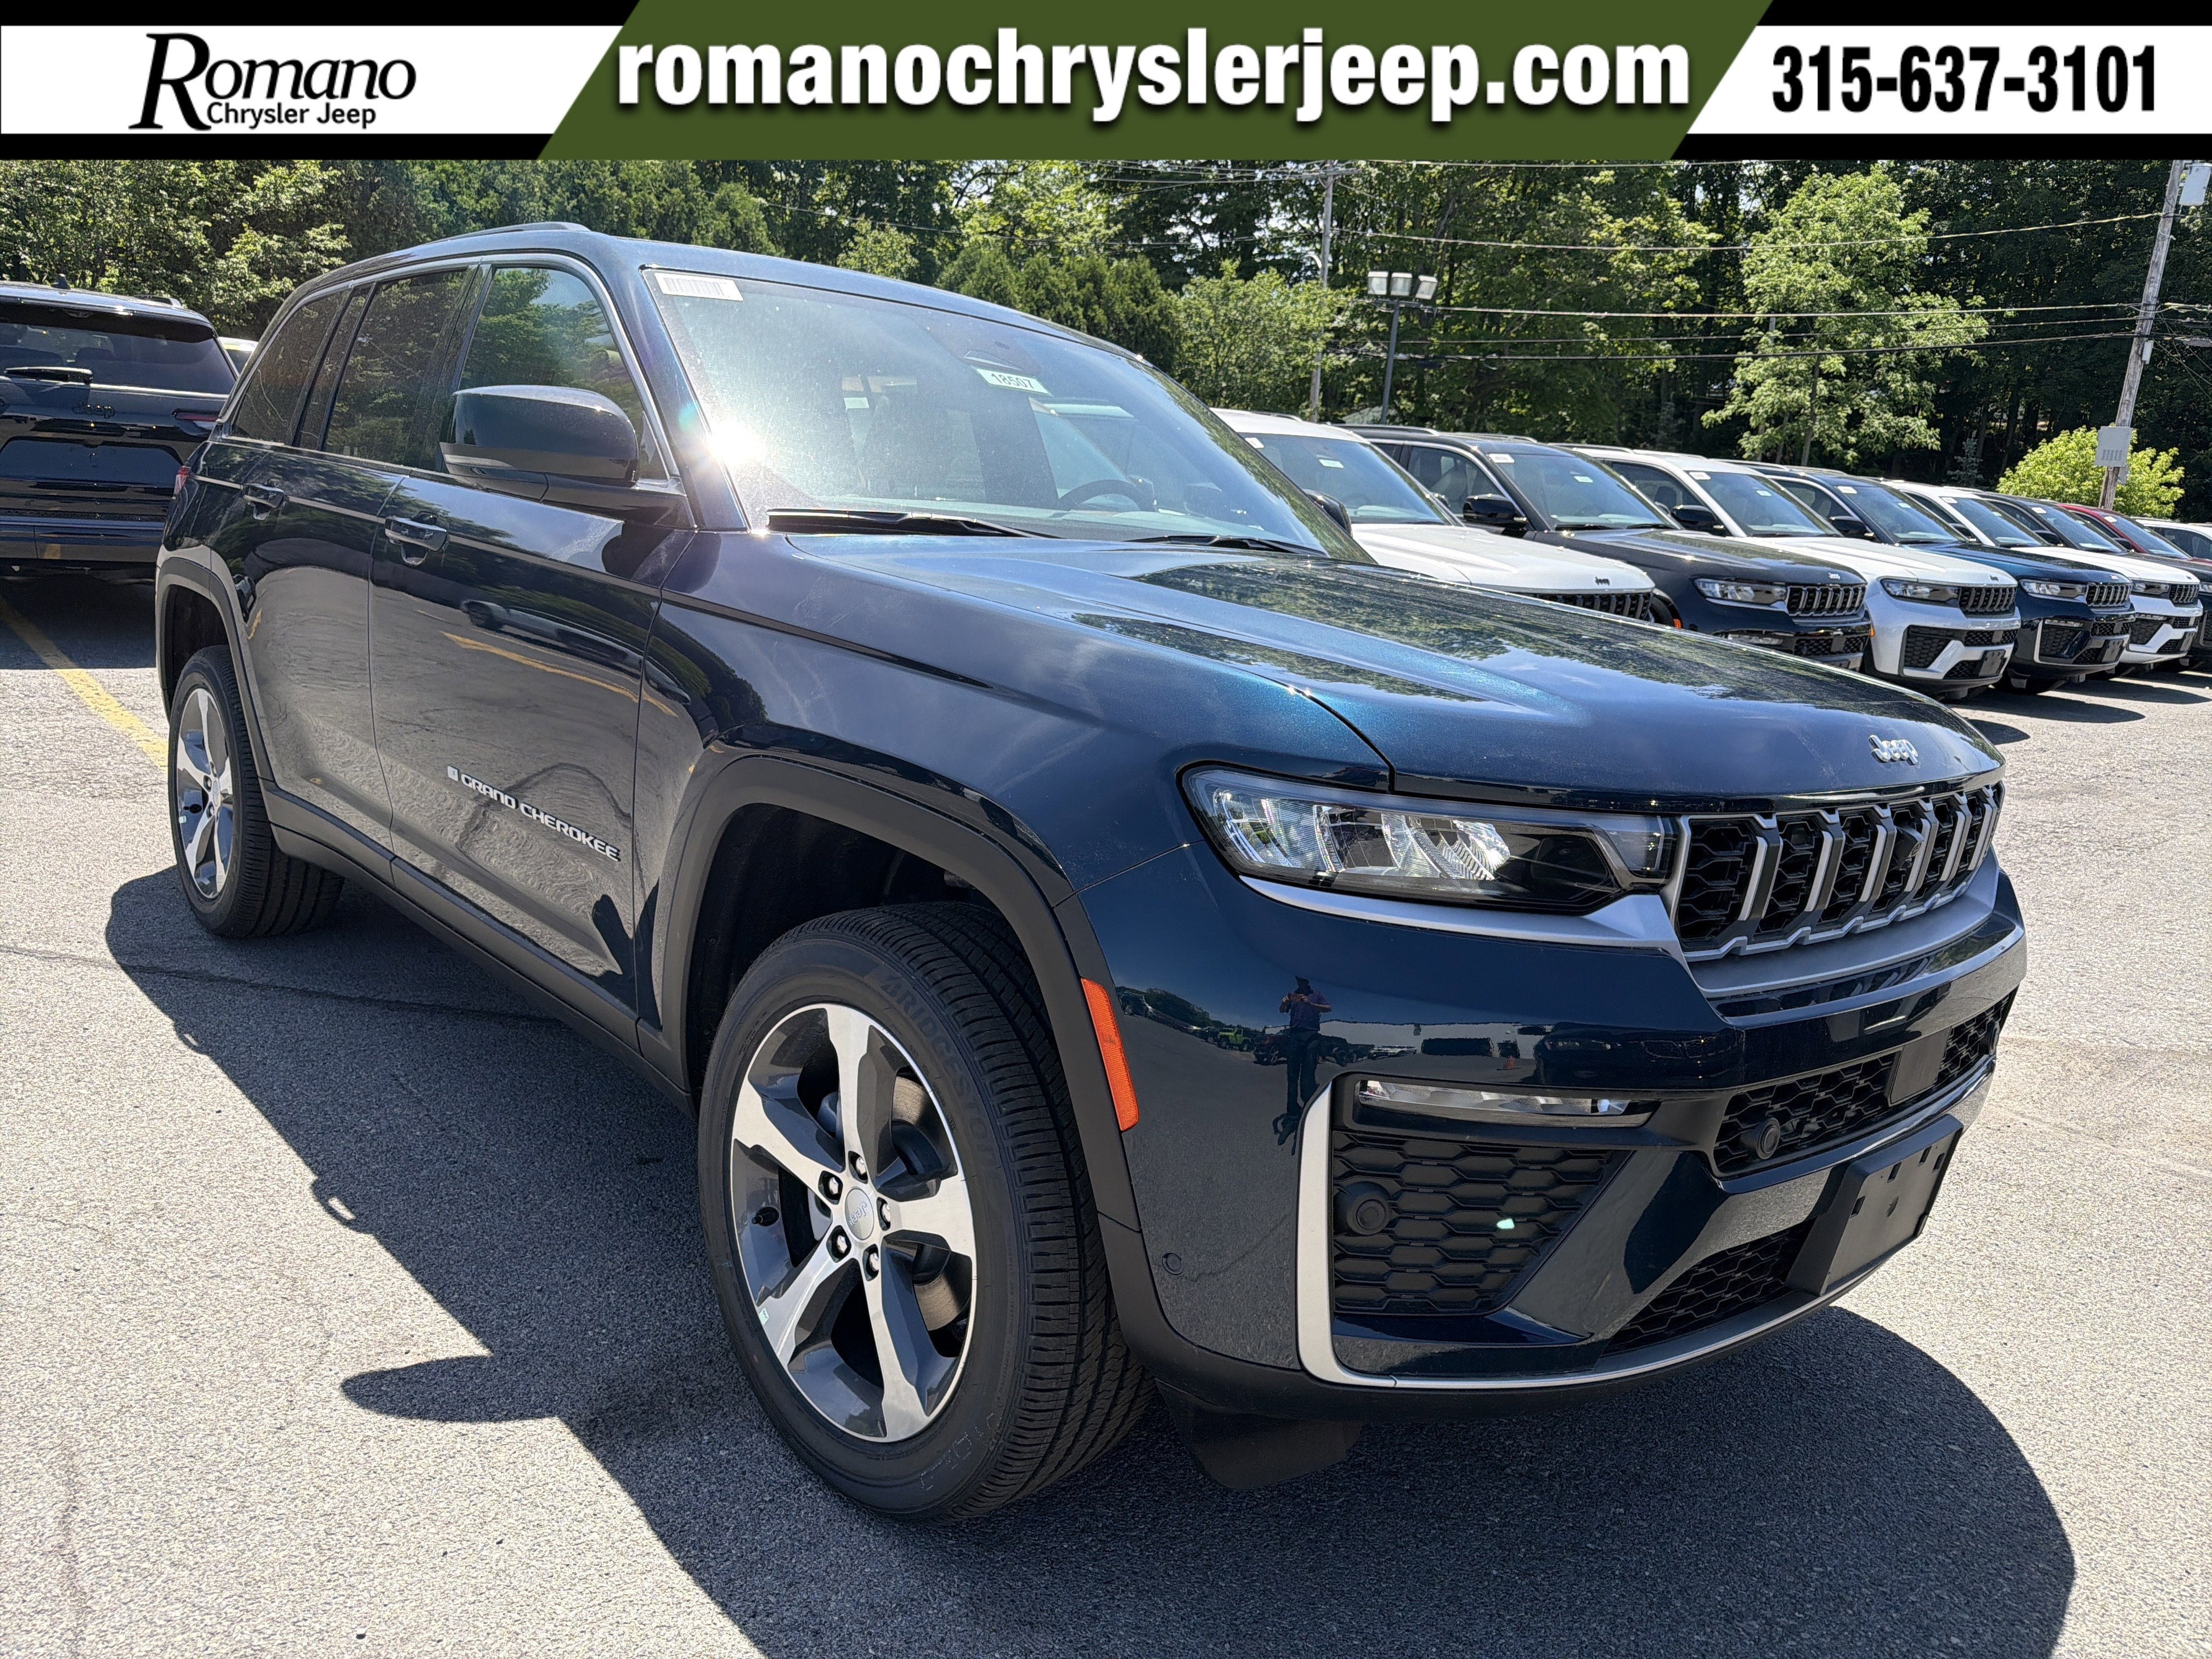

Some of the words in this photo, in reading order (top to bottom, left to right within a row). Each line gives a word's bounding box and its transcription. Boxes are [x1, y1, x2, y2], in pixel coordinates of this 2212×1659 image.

[991, 373, 1034, 389] 18507
[1868, 735, 1918, 765] Jeep
[461, 774, 518, 810] GRAND
[520, 802, 622, 862] CHEROKEE
[848, 1201, 867, 1227] Jeep
